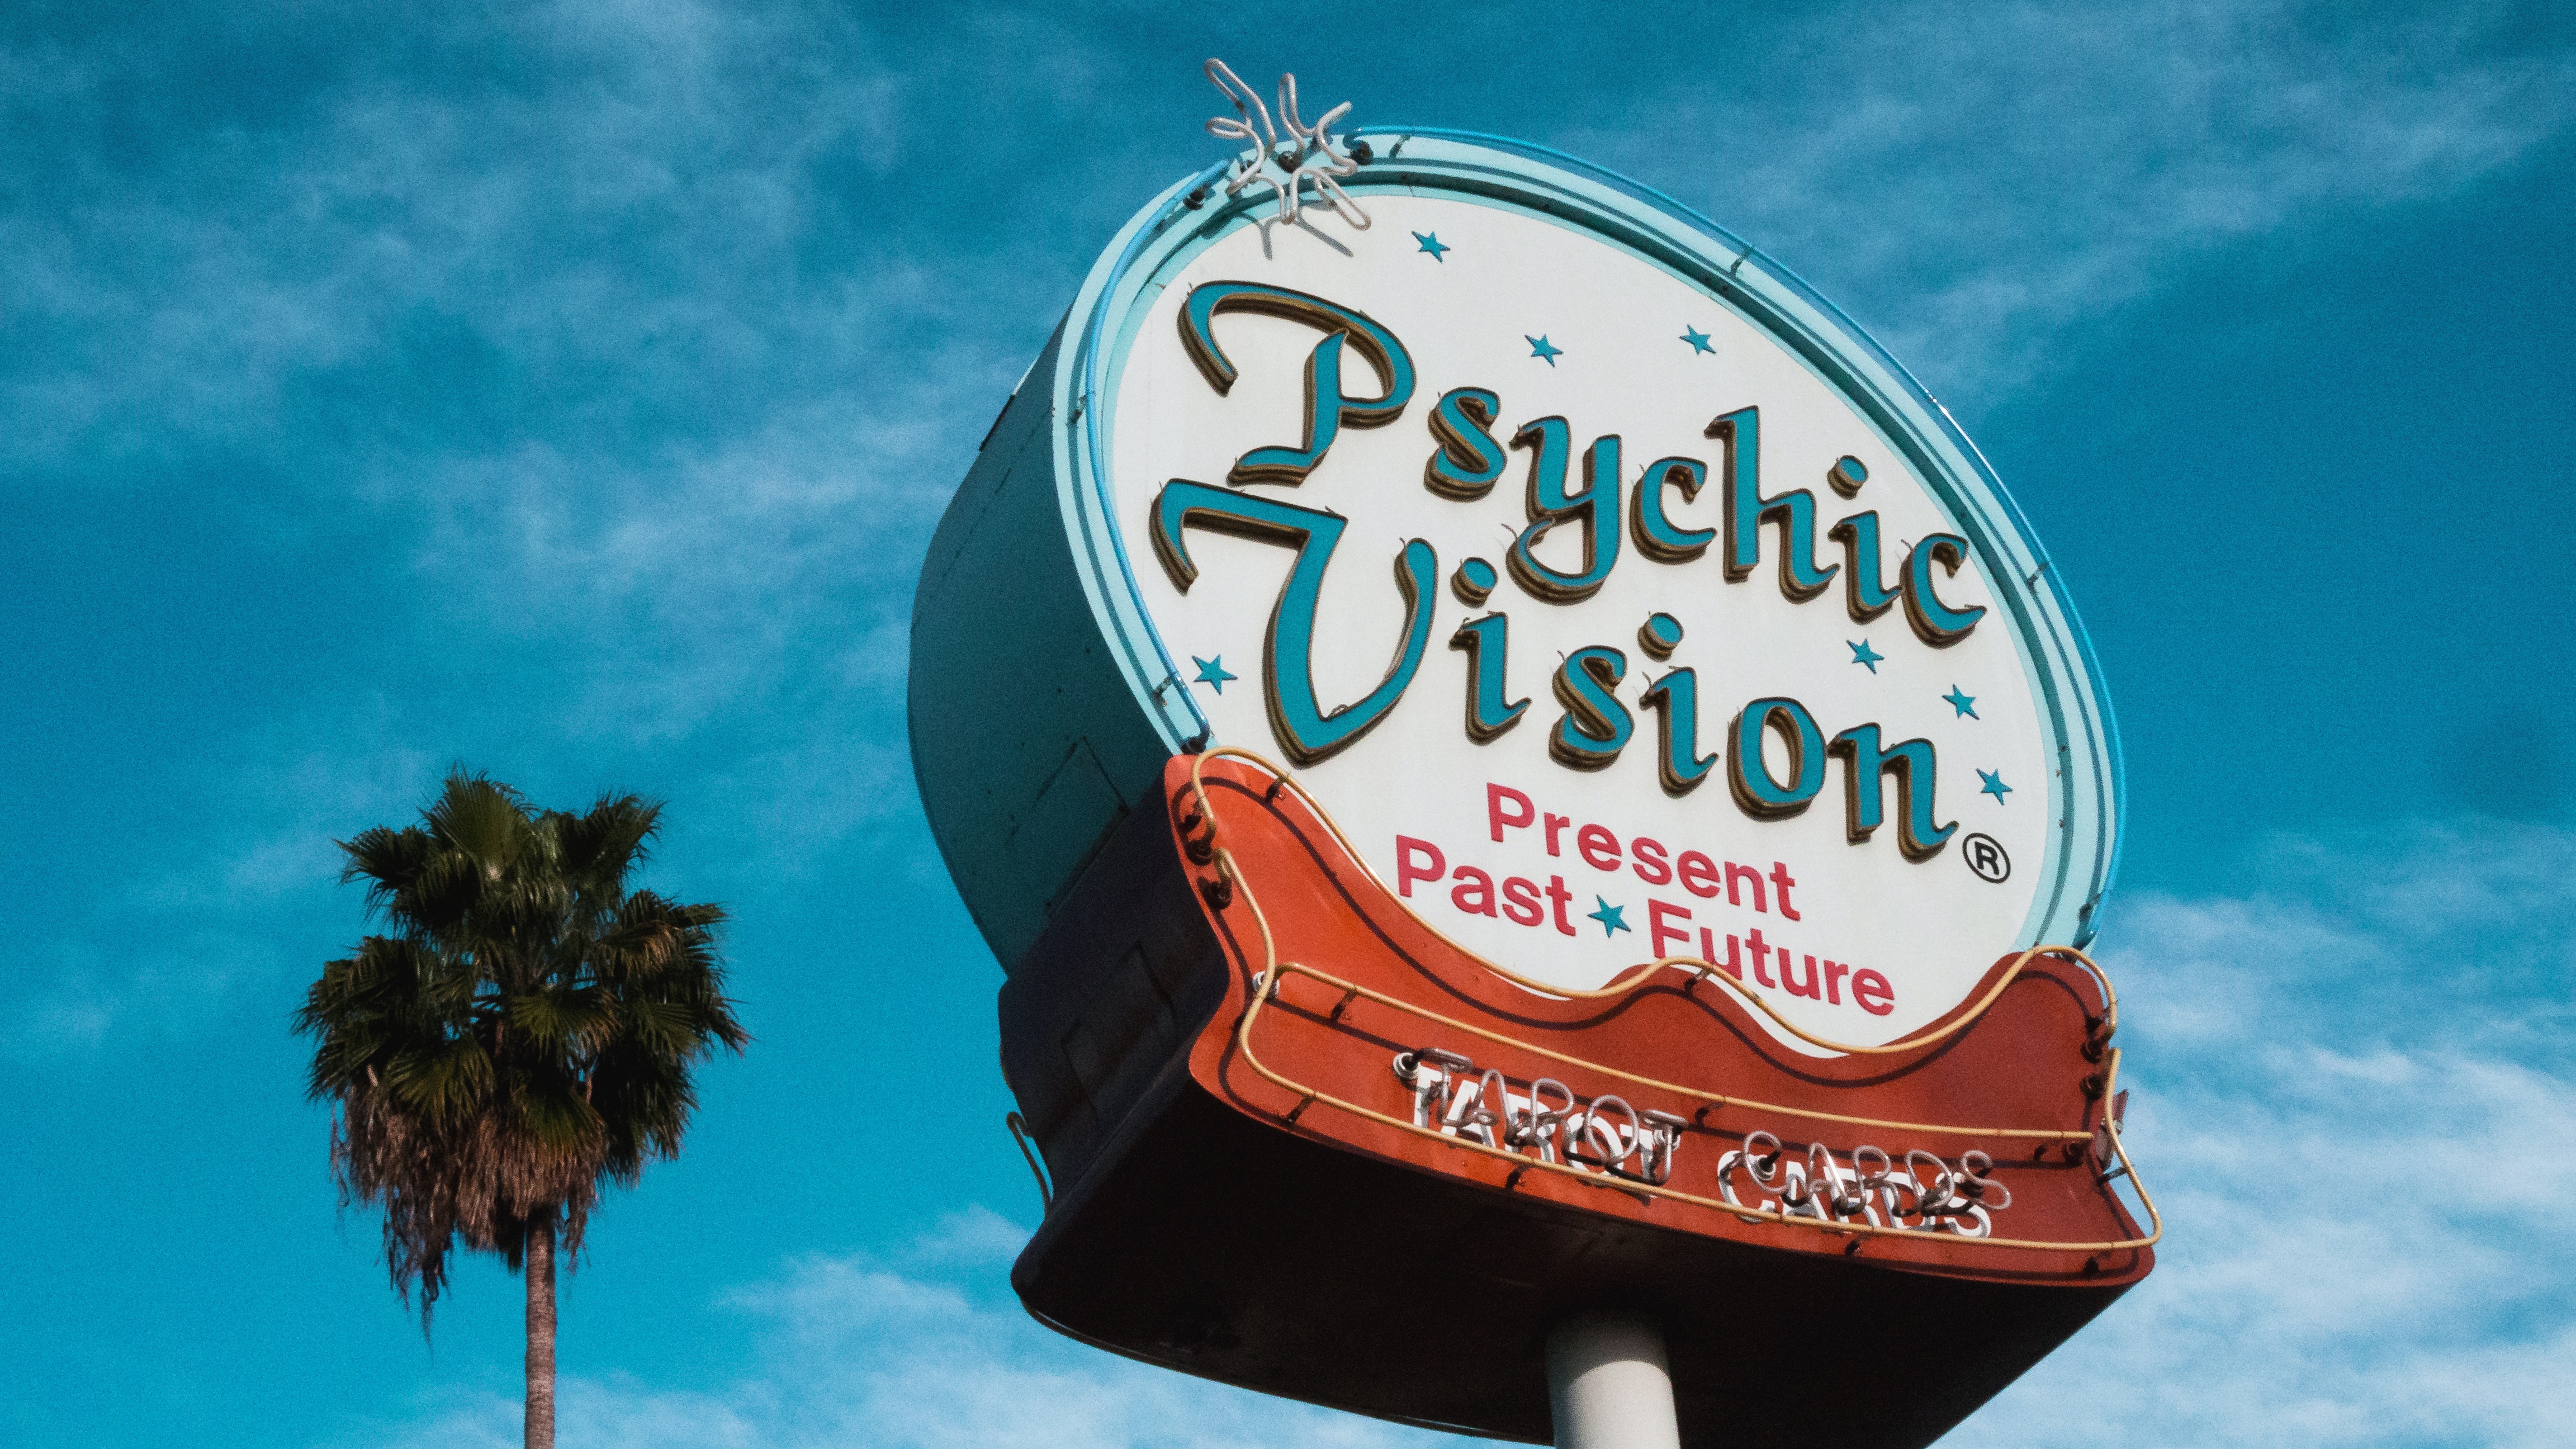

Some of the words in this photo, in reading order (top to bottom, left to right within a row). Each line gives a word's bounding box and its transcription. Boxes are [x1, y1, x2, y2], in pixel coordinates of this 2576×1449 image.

[1177, 280, 1987, 649] Psychic
[1149, 477, 1959, 864] Vision
[1395, 834, 1576, 936] Past
[1648, 898, 1895, 1016] Future
[1487, 782, 1801, 922] Present
[1412, 1047, 1687, 1198] TAROT
[1716, 1130, 2012, 1238] CARDS
